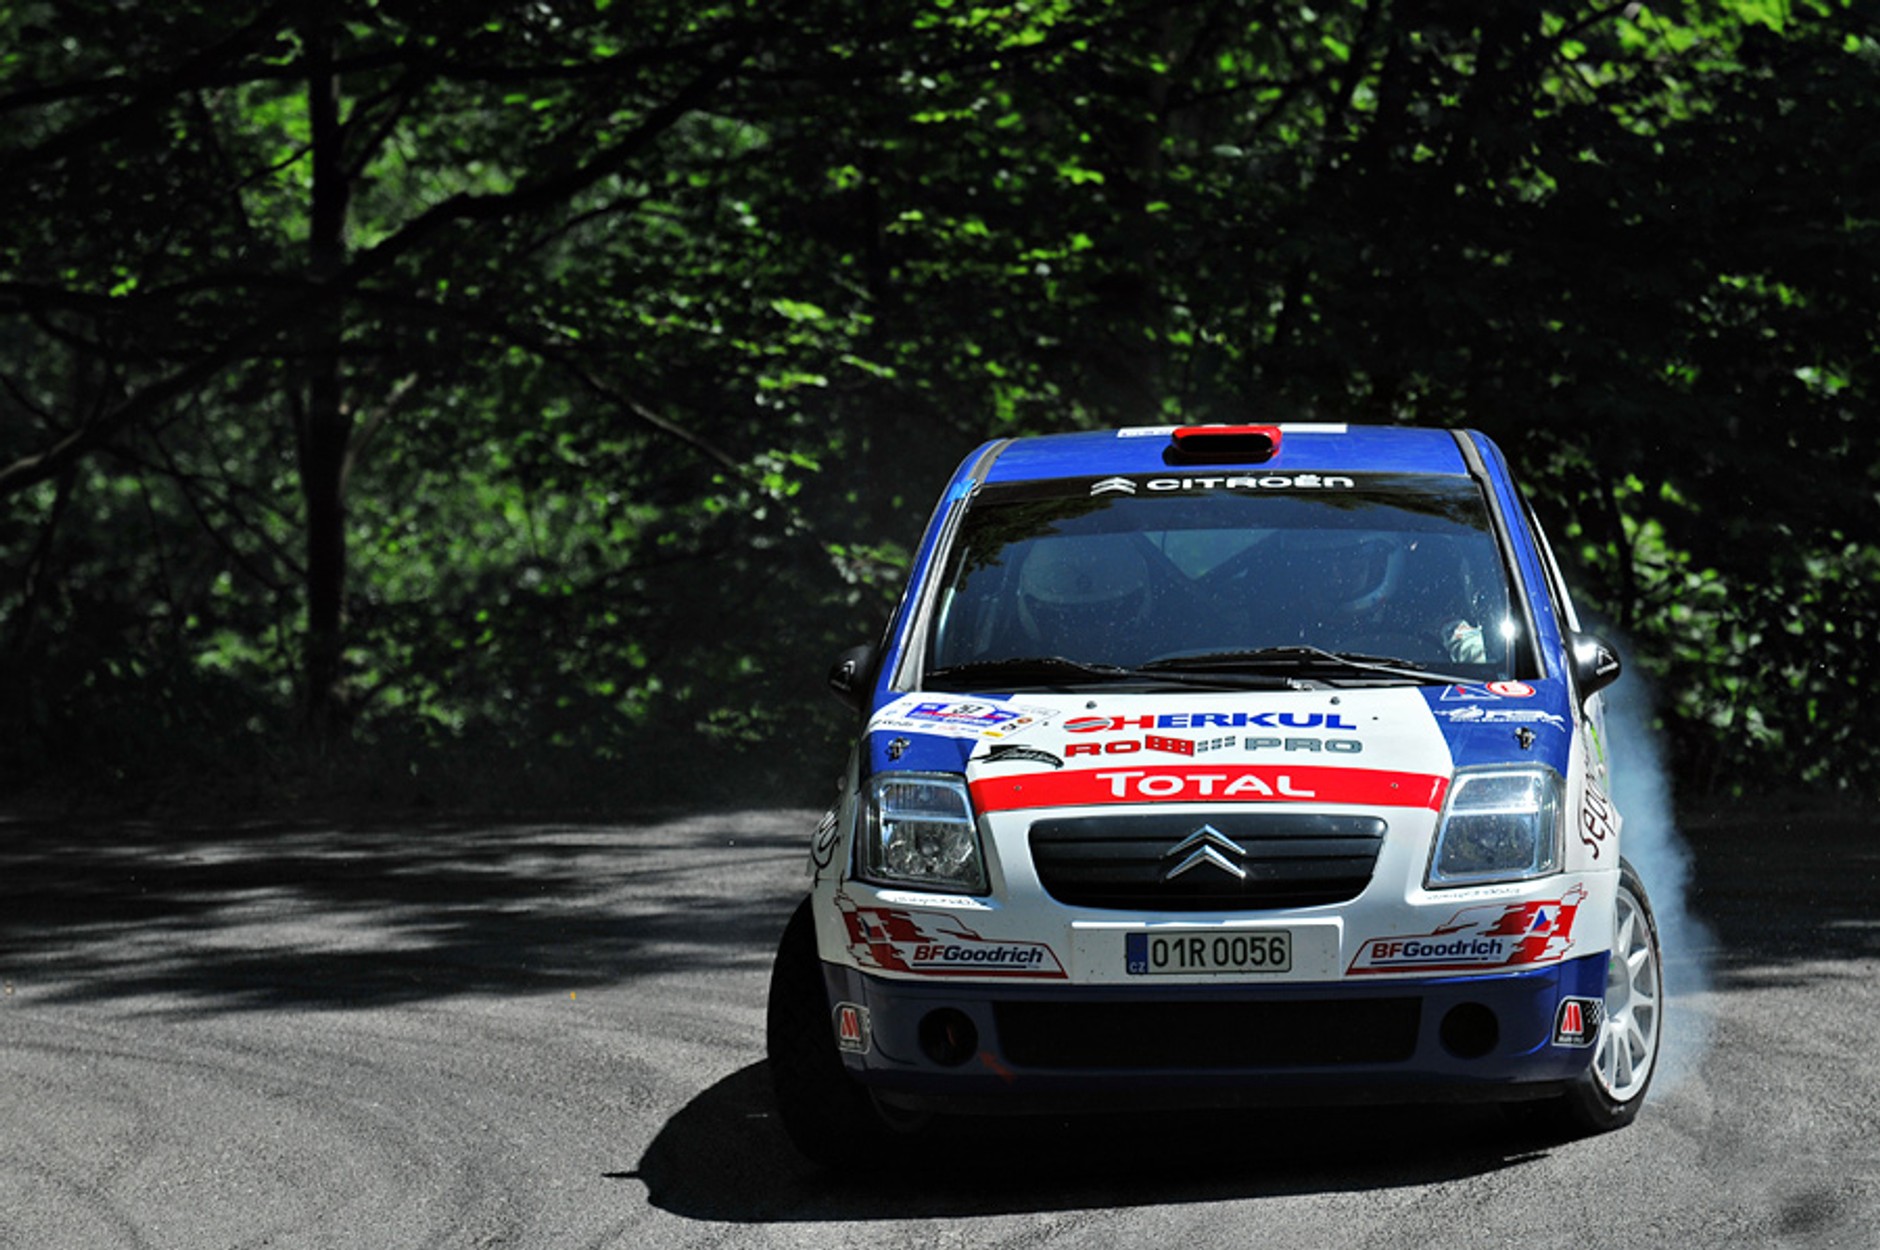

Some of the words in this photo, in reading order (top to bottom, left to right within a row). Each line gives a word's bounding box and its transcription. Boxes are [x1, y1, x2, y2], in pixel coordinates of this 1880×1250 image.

[1107, 713, 1357, 731] HERKUL
[1245, 737, 1363, 754] PRO
[1096, 771, 1315, 798] TOTAL
[913, 944, 1044, 963] BFGoodrich
[1152, 937, 1206, 967] 01R
[1213, 937, 1286, 966] 0056
[1371, 938, 1504, 959] BFGoodrich
[1129, 962, 1146, 973] CZ
